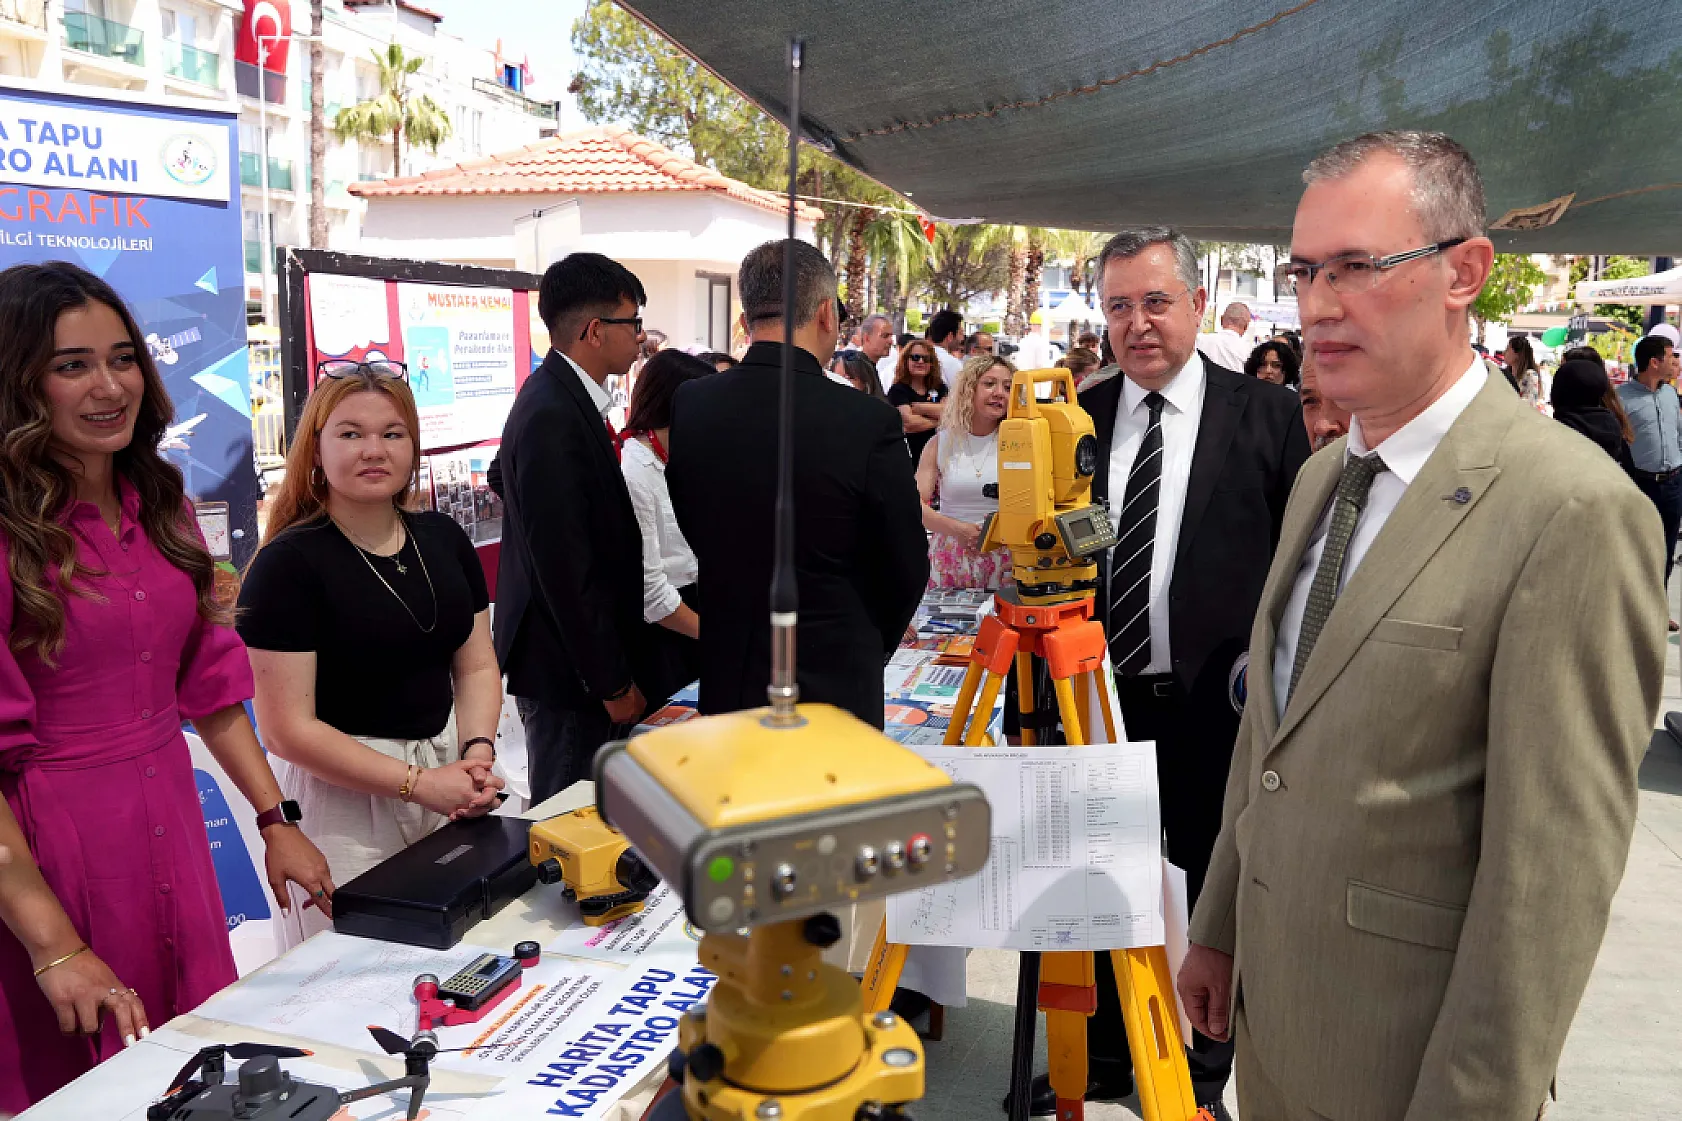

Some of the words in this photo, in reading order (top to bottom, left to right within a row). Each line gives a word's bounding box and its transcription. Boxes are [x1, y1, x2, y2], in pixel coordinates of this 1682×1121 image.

[18, 119, 102, 149] TAPU
[44, 152, 138, 182] ALANI
[36, 233, 153, 252] TEKNOLOJİLERİ
[428, 292, 478, 309] MUSTAFA
[527, 1023, 631, 1087] HARİTA
[607, 968, 675, 1015] TAPU
[546, 1015, 678, 1117] KADASTRO
